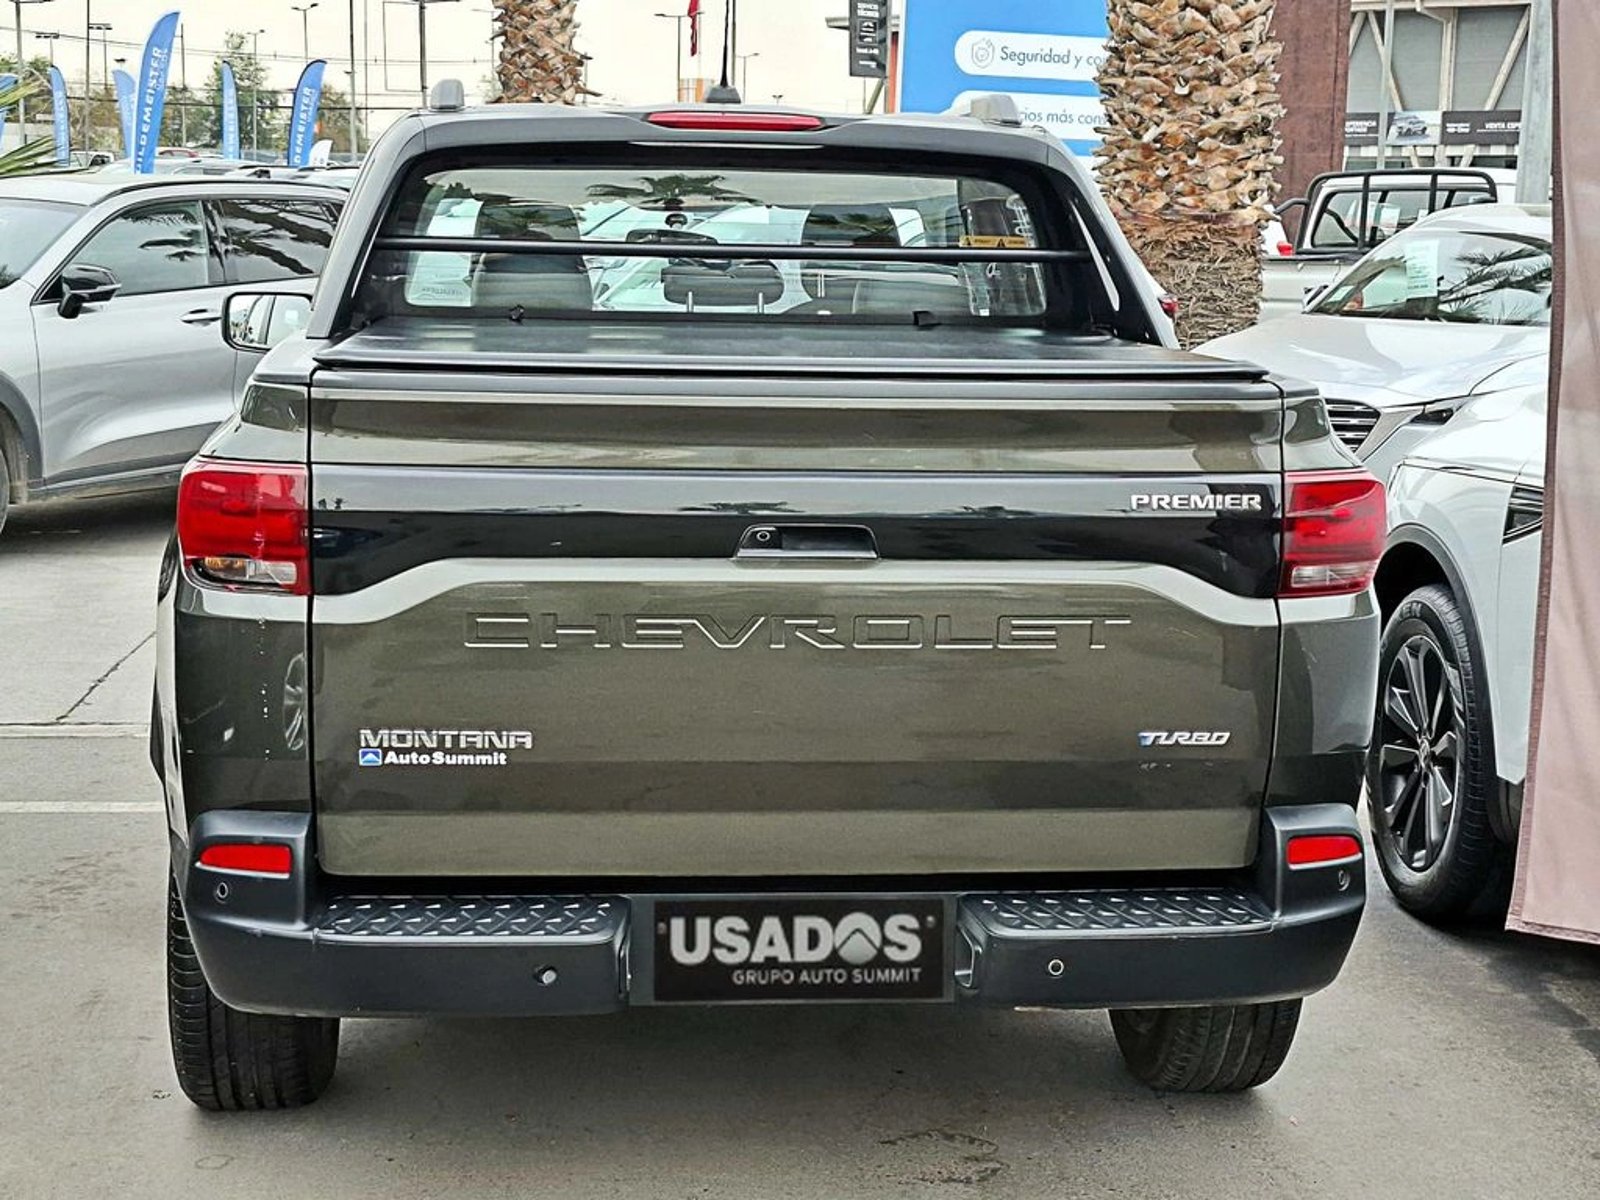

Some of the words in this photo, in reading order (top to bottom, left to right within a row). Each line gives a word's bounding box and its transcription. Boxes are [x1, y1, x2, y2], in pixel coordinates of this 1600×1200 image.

[1000, 46, 1071, 66] Seguridad
[1074, 55, 1082, 69] y
[1046, 107, 1074, 123] más
[1130, 493, 1262, 511] PREMIER
[464, 612, 1132, 650] CHEVROLET
[358, 729, 534, 750] MONTANA
[1138, 731, 1232, 747] TURBO
[668, 911, 923, 965] USADOS
[732, 970, 795, 985] GRUPO
[799, 969, 848, 984] AUTO
[852, 967, 922, 983] SUMMIT
